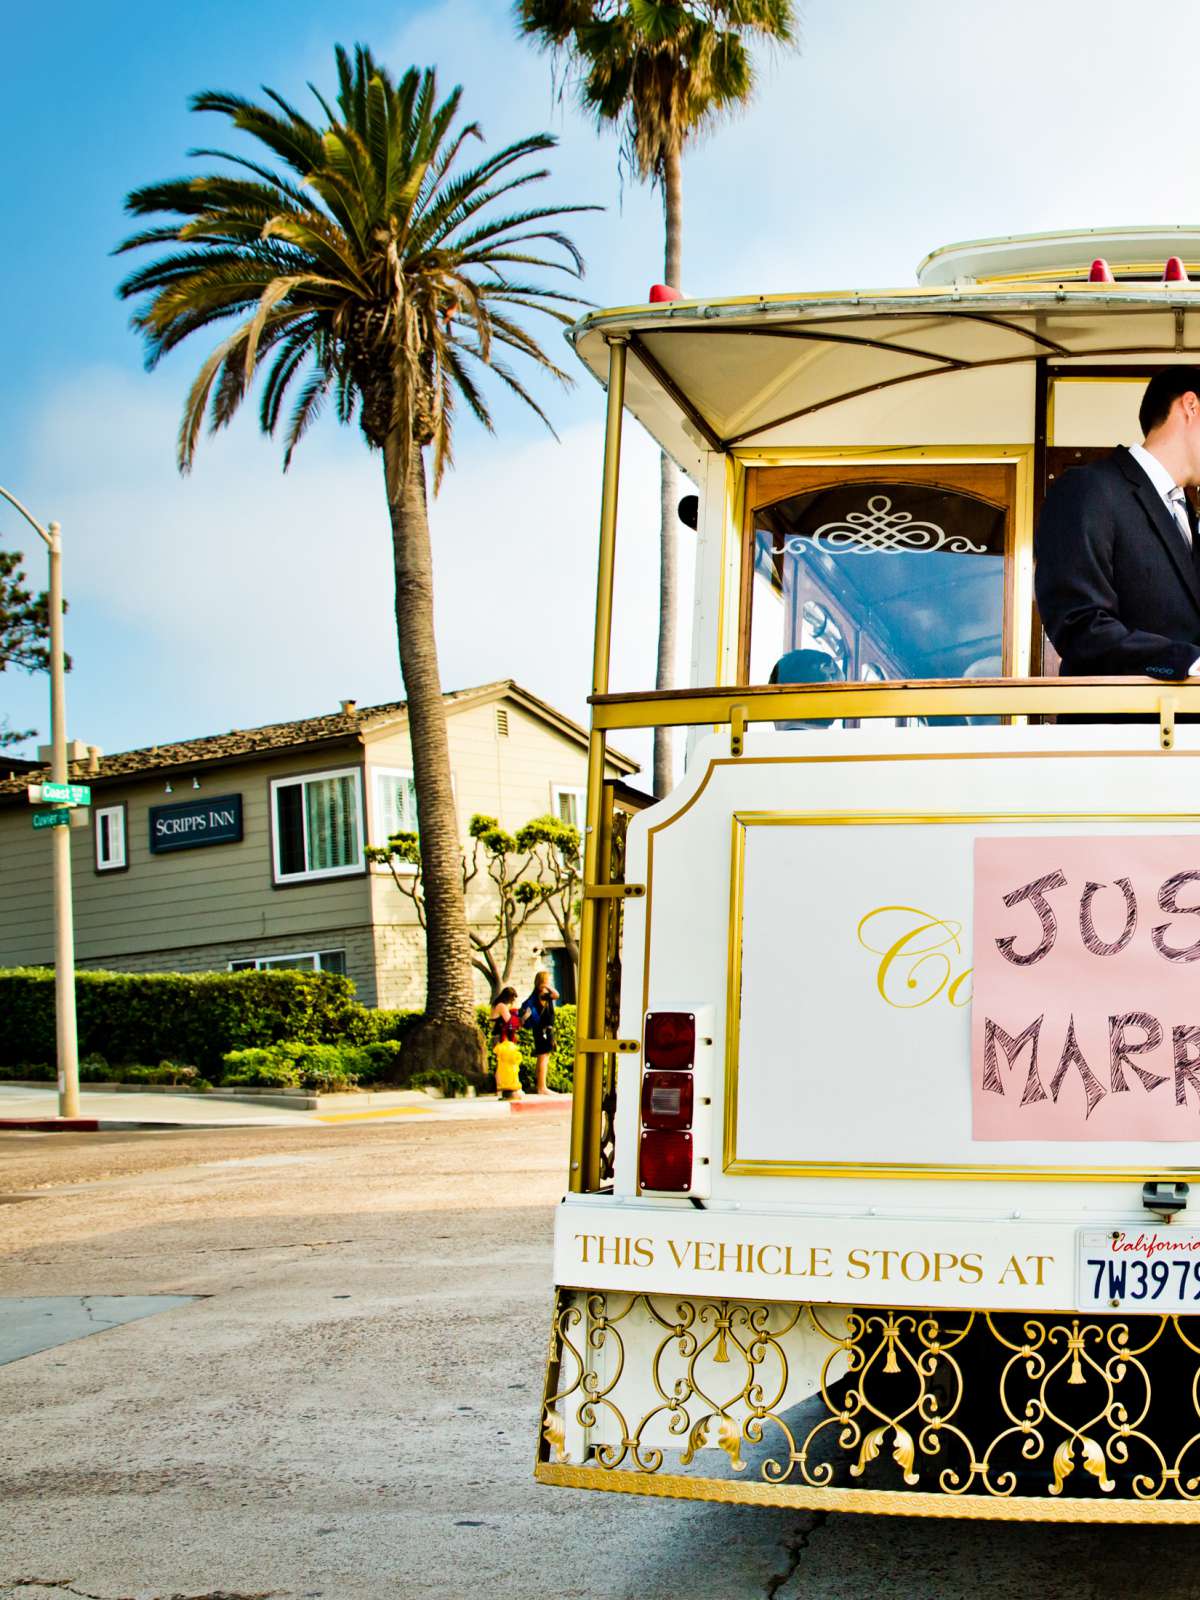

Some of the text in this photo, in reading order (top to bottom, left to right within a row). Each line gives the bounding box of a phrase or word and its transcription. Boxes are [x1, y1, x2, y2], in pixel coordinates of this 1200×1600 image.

[156, 810, 235, 836] SCRIPPS INN
[574, 1233, 1055, 1287] THIS VEHICLE STOPS AT
